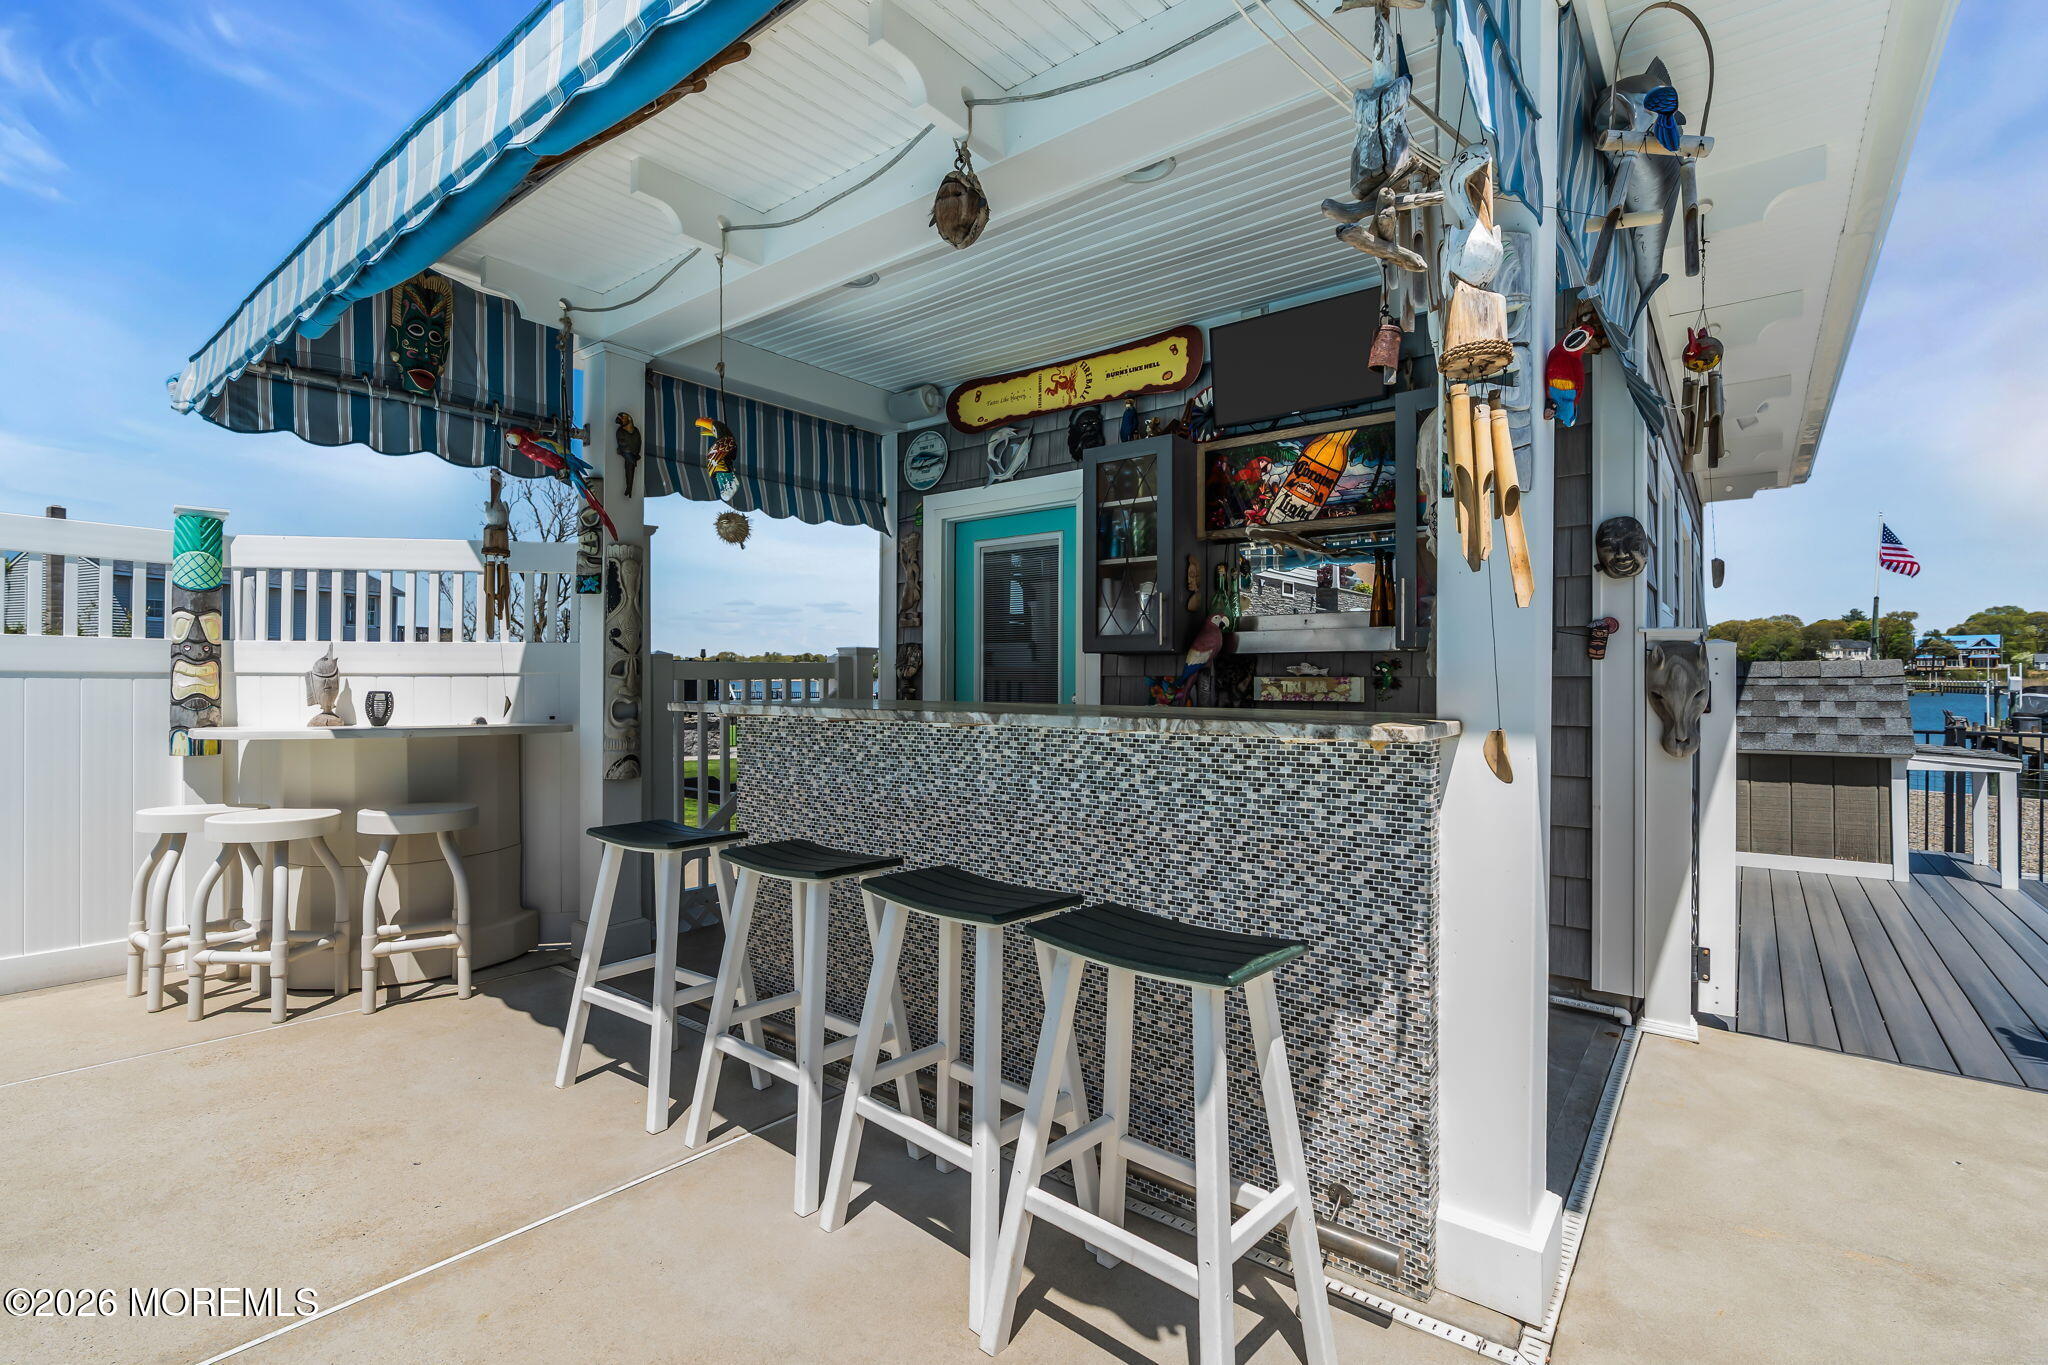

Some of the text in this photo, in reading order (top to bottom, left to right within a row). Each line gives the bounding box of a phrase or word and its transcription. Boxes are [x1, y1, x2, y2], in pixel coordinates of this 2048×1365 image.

[1105, 361, 1160, 379] BURNS LIKE HELL
[1079, 360, 1093, 401] FIREBALL
[1280, 680, 1302, 693] TIKI
